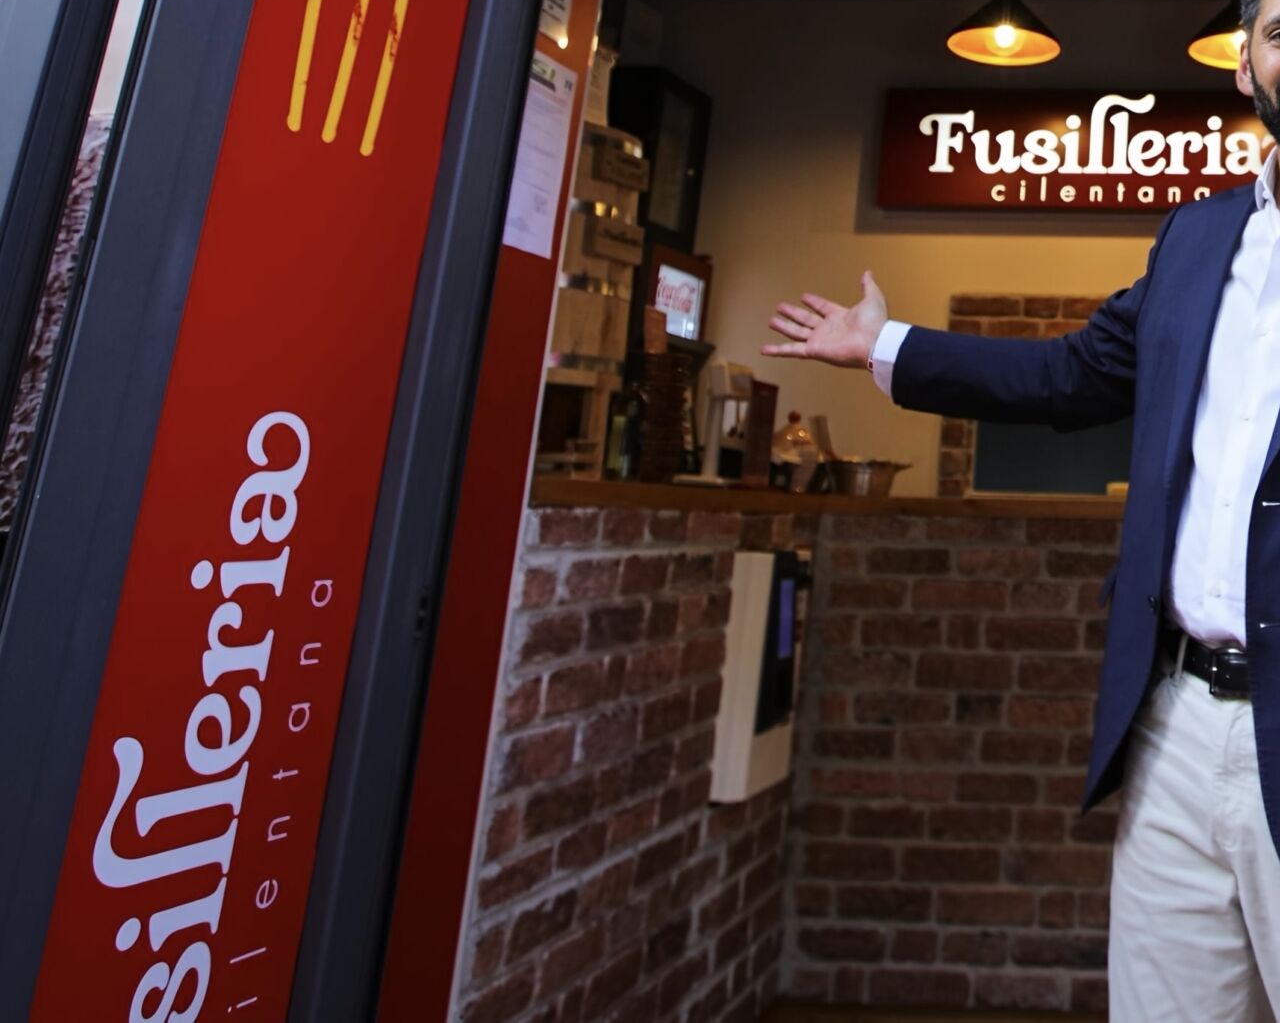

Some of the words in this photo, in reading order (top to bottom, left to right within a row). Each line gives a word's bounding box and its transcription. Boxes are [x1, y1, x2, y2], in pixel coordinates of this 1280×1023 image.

[919, 93, 1276, 176] Fusilleria
[991, 176, 1211, 203] cilentana
[92, 410, 311, 1023] silleria
[226, 578, 334, 1014] ilentana
